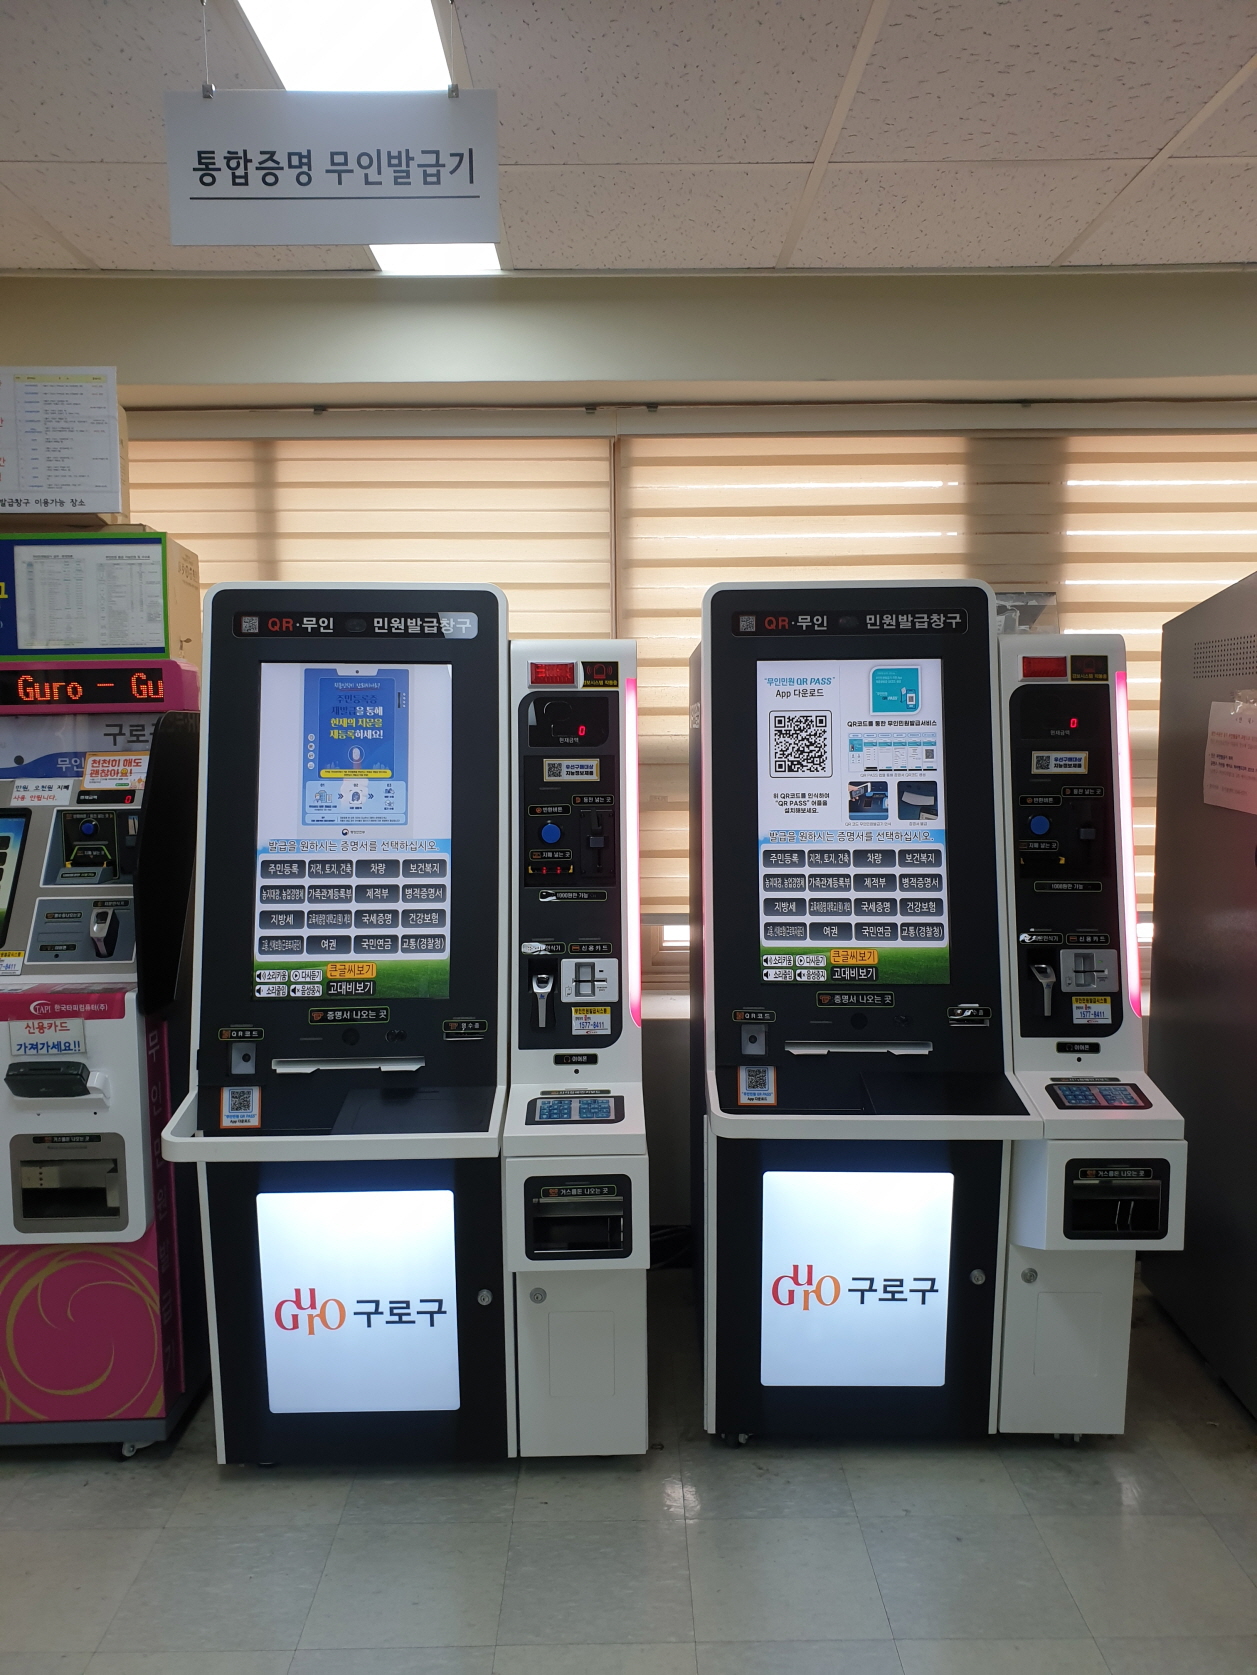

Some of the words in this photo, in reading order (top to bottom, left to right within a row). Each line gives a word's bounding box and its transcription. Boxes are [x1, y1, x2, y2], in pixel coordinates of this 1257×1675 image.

[193, 148, 313, 187] 통합증명
[324, 147, 475, 186] 무인발급기
[35, 498, 66, 508] 이용가능
[69, 498, 86, 508] 장소
[373, 616, 472, 634] 민원발급창구
[865, 612, 963, 630] 민원발급창구
[17, 674, 84, 701] Guro
[796, 677, 808, 686] QR
[336, 694, 378, 704] 주민등록증
[775, 689, 791, 699] App
[793, 688, 824, 699] 다운로드
[331, 705, 364, 716] 재발급을
[365, 705, 383, 716] 통해
[330, 717, 356, 728] 현재의
[357, 717, 383, 728] 지문을
[846, 720, 874, 728] QR코드를
[875, 720, 886, 728] 통한
[1069, 717, 1078, 728] 0
[103, 722, 158, 747] 구로
[329, 729, 384, 740] 재등록하세요!
[578, 725, 586, 736] 0
[91, 758, 121, 768] 천천히
[89, 768, 133, 778] 괜찮아요!
[33, 784, 54, 792] 오천원
[12, 794, 27, 802] 사용
[124, 795, 132, 804] 0
[779, 792, 807, 800] QR코드를
[769, 831, 797, 843] 발급을
[798, 831, 835, 843] 원하시는
[836, 831, 874, 843] 증명서를
[875, 831, 934, 843] 선택하십시오.
[268, 839, 297, 853] 발급을
[299, 839, 338, 853] 원하시는
[340, 839, 378, 853] 증명서를
[380, 839, 441, 853] 선택하십시오.
[769, 853, 799, 865] 주민등록
[866, 853, 882, 865] 차량
[904, 853, 935, 865] 보건복지
[267, 862, 300, 875] 주민등록
[370, 862, 386, 875] 차량
[409, 862, 440, 875] 보건복지
[808, 877, 851, 889] 가족관계등록부
[863, 877, 887, 889] 제적부
[901, 877, 939, 889] 병적증명서
[308, 888, 353, 900] 가족관계등록부
[366, 888, 389, 900] 제적부
[405, 888, 443, 900] 병적증명서
[774, 901, 797, 913] 지방세
[860, 901, 891, 913] 국세증명
[906, 901, 936, 913] 건강보험
[270, 913, 294, 926] 지방세
[361, 913, 393, 926] 국세증명
[408, 913, 440, 926] 건강보험
[823, 925, 838, 937] 여권
[861, 925, 892, 937] 국민연금
[901, 925, 943, 937] 교통(경찰청)
[320, 938, 337, 951] 여권
[361, 938, 393, 951] 국민연금
[401, 938, 446, 951] 교통(경찰청)
[1079, 935, 1106, 943] 신용카드
[581, 944, 609, 952] 신용카드
[805, 955, 826, 966] 다시듣기
[831, 950, 876, 963] 큰글씨보기
[301, 970, 322, 981] 다시듣기
[328, 963, 374, 978] 큰글씨보기
[832, 967, 877, 981] 고대비보기
[328, 981, 374, 995] 고대비보기
[833, 994, 857, 1004] 증명서
[859, 994, 882, 1004] 나오는
[883, 993, 893, 1004] 곳
[35, 1004, 52, 1014] TAPI
[54, 1003, 108, 1012] 한국타피컴퓨터(주)
[326, 1010, 350, 1020] 증명서
[352, 1010, 377, 1020] 나오는
[378, 1008, 387, 1019] 곳
[1079, 1010, 1105, 1018] 1577-8411
[24, 1021, 71, 1036] 신용카드
[579, 1021, 605, 1030] 1577-8411
[16, 1040, 82, 1055] 가져가세요!!
[847, 1276, 940, 1306] 구로구
[353, 1297, 448, 1329] 구로구
